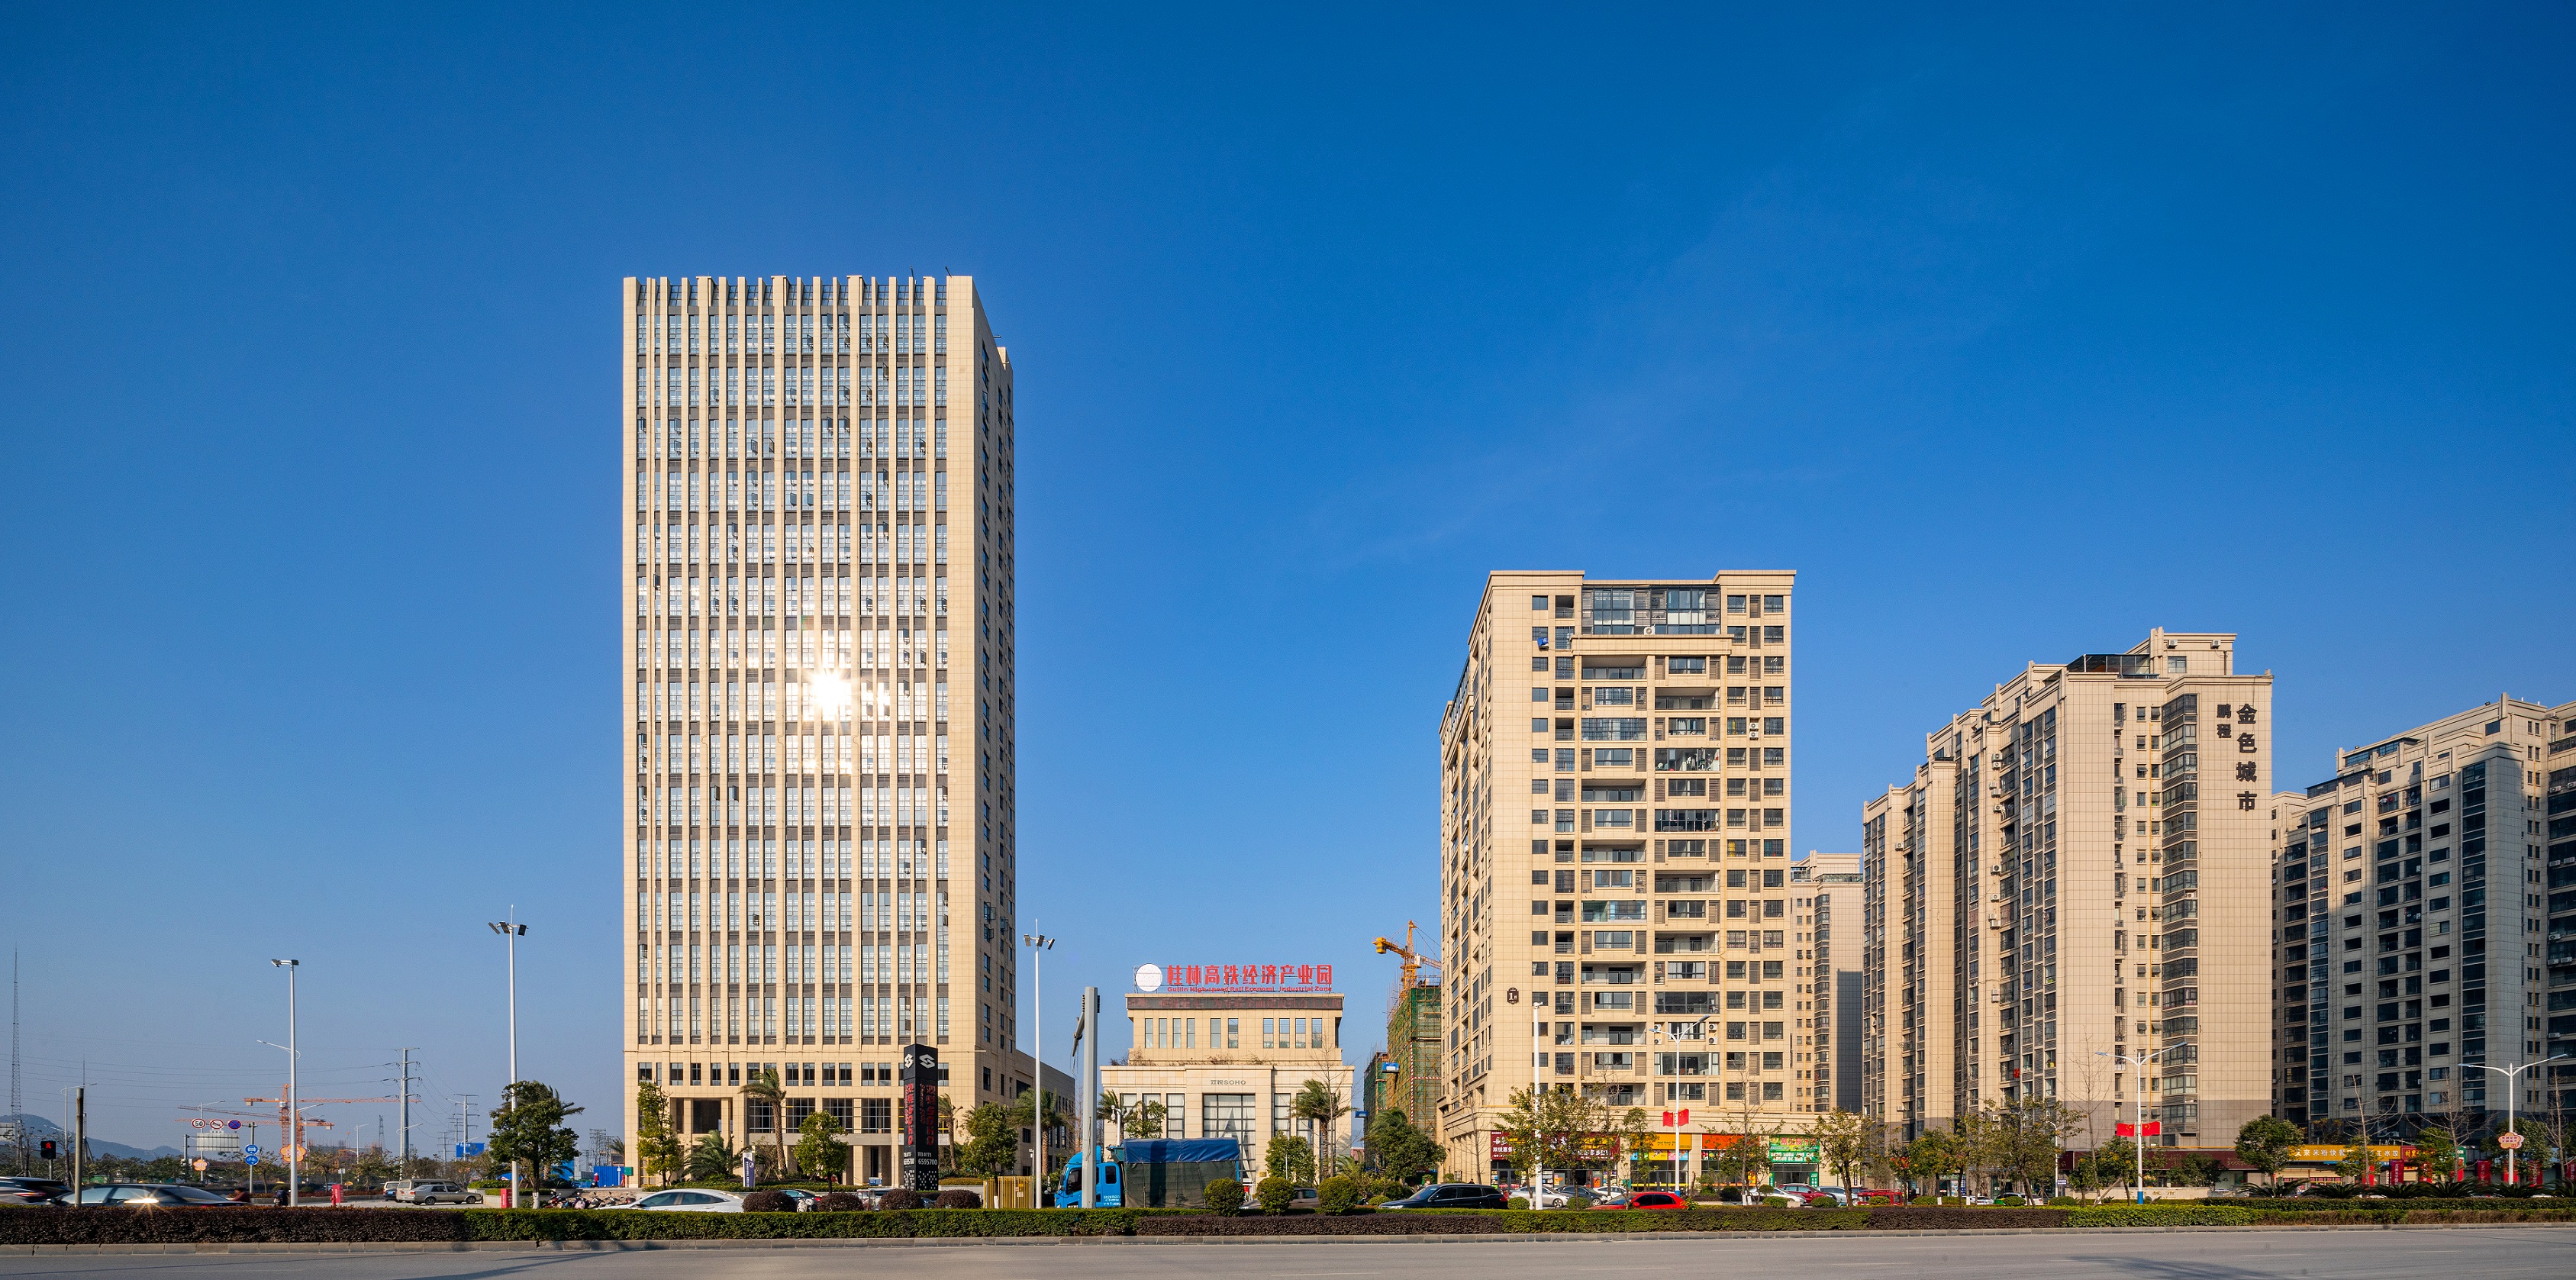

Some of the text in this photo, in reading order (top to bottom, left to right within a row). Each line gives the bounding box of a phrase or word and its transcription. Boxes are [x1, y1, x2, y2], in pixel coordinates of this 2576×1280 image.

[2217, 704, 2231, 738] 鹏程
[2236, 704, 2257, 811] 金色城市
[1167, 964, 1332, 985] 桂林高铁经济产业园
